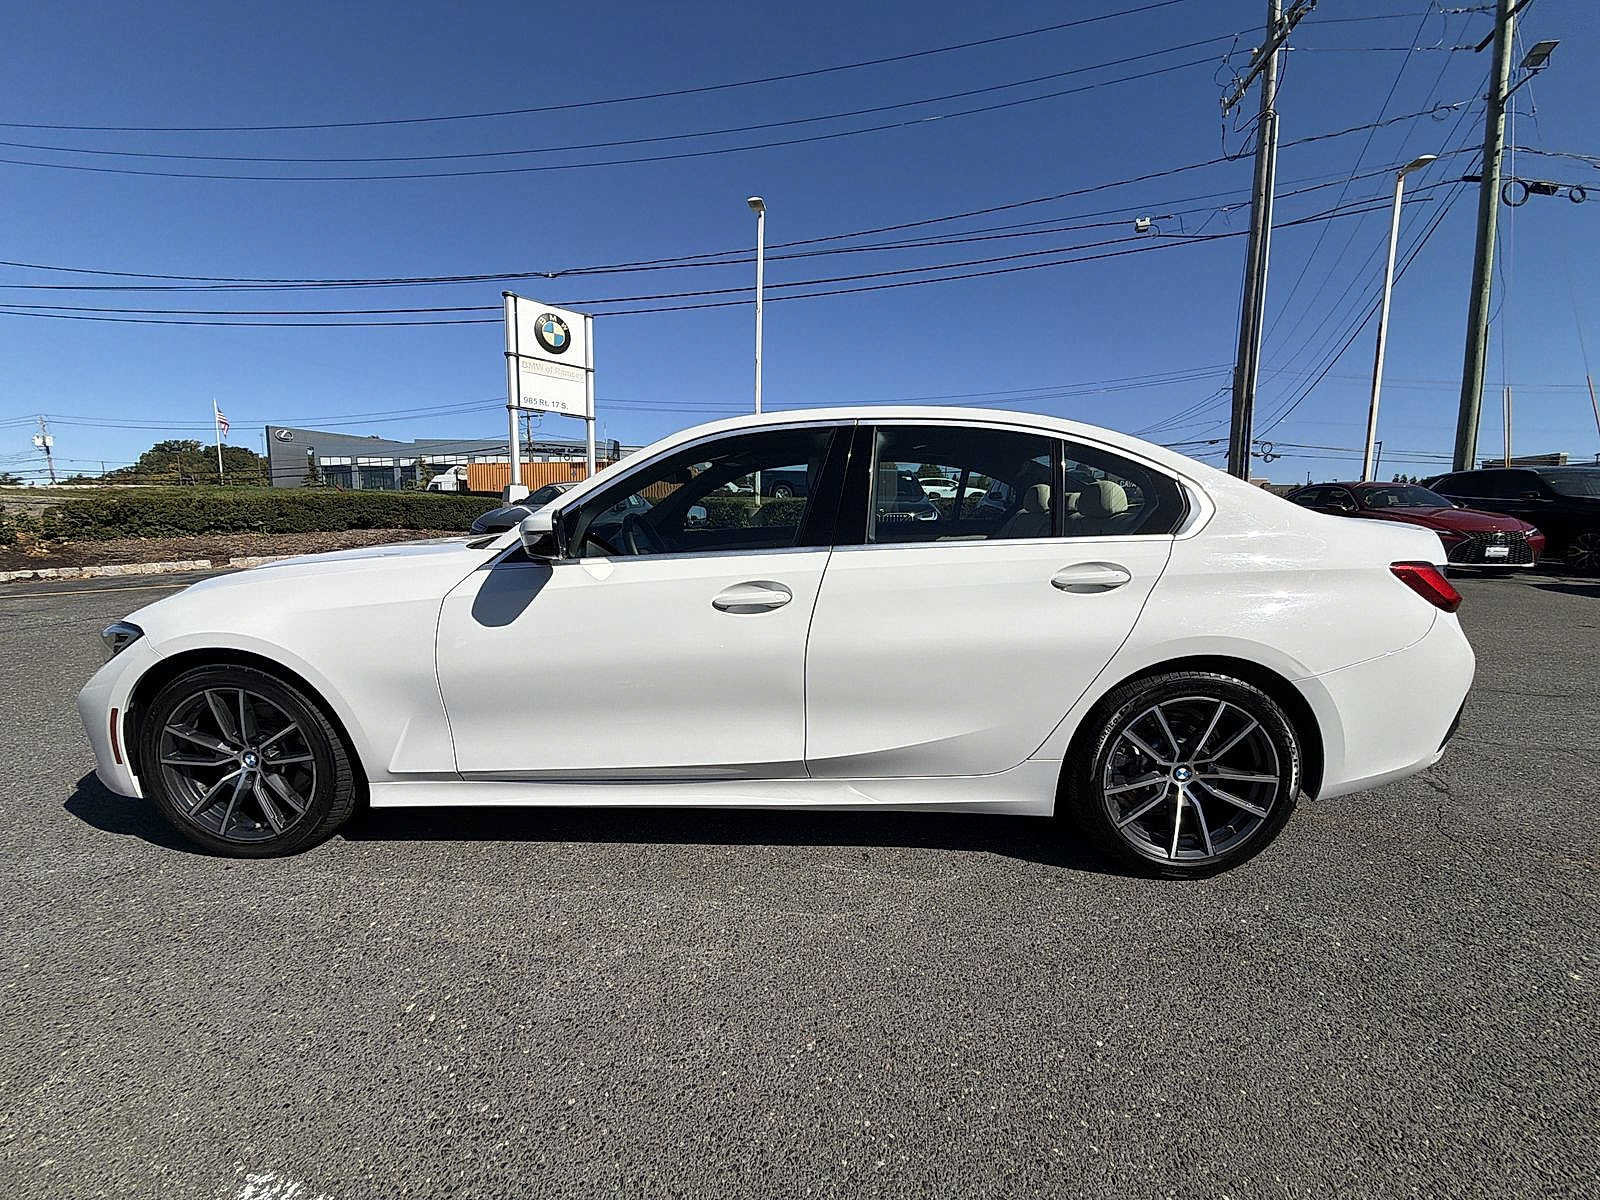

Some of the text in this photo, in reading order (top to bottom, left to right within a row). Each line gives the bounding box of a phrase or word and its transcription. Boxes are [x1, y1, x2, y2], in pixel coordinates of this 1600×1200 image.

[537, 314, 569, 331] BMW
[521, 360, 544, 372] BMW
[523, 396, 538, 406] 985
[551, 400, 560, 408] 17
